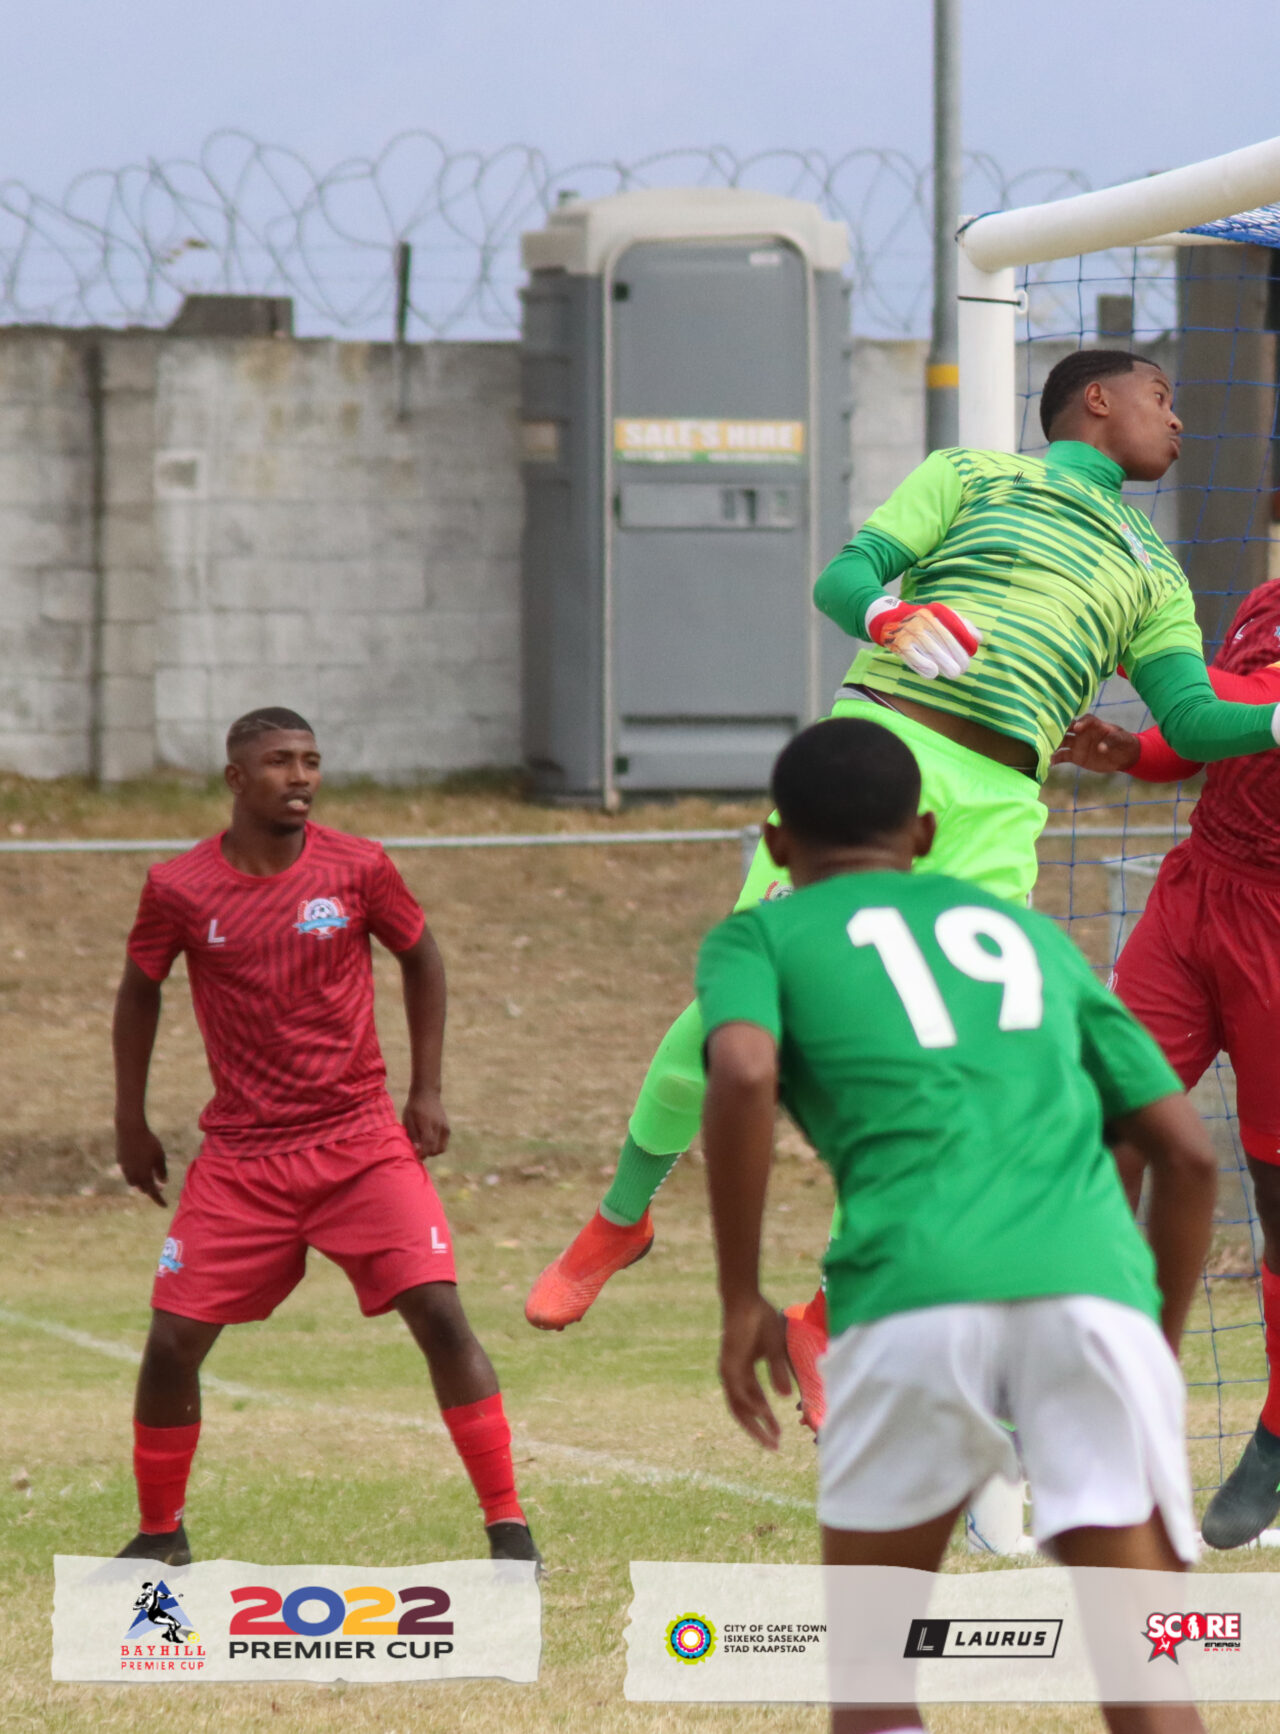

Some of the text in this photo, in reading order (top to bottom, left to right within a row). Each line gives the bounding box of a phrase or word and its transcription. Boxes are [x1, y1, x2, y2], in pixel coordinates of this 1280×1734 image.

[208, 919, 226, 944] L
[846, 906, 1044, 1048] 19
[430, 1226, 447, 1250] L
